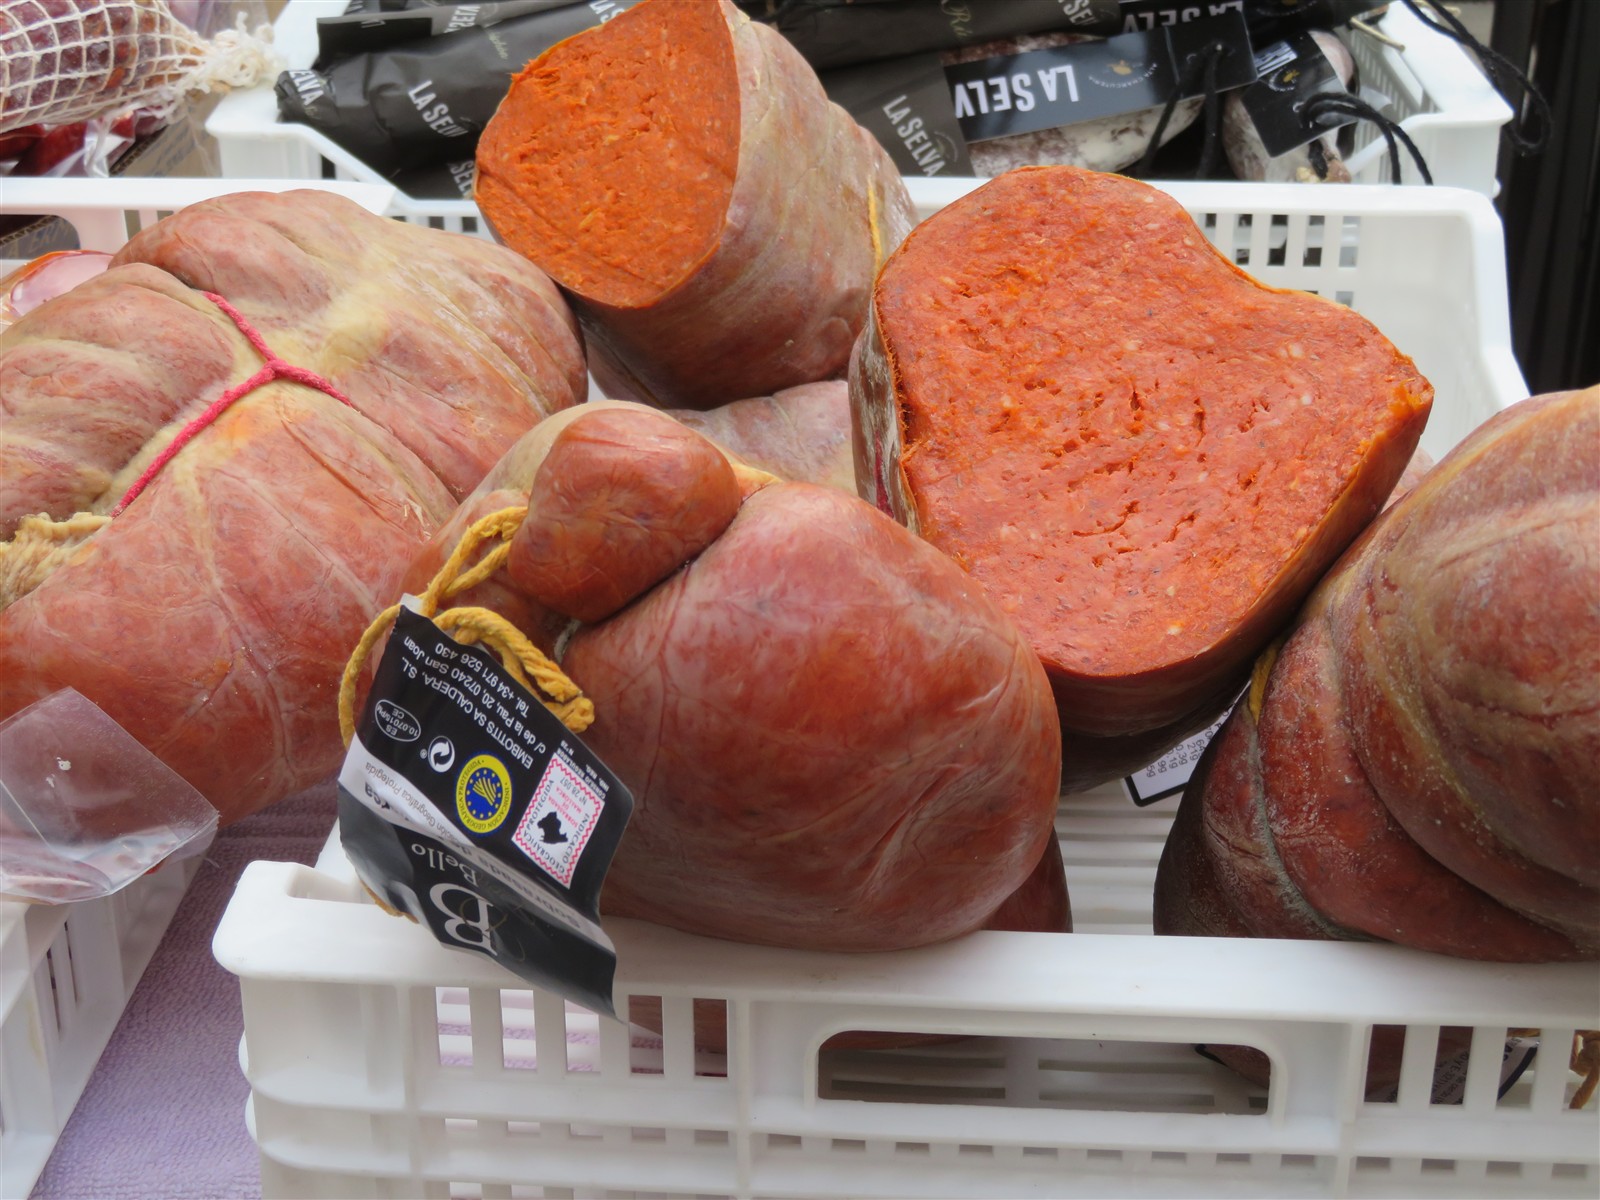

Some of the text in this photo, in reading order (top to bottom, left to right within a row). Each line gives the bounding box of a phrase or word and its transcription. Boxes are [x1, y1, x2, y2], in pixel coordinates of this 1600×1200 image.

[407, 79, 437, 111] LA
[954, 63, 1080, 119] LA SELV
[882, 94, 946, 178] LA SELVA
[403, 636, 547, 754] c/ de la Pau, 20, 07240 San Joan
[434, 642, 530, 718] Tel. +34 971 526 430
[385, 724, 398, 736] ES
[391, 708, 405, 719] CE
[401, 656, 534, 769] EMBOTITS SA CALDERA, S.L.
[365, 761, 401, 796] Protegida
[525, 779, 555, 831] PROTEGIDA
[410, 843, 479, 886] Bello
[429, 882, 498, 957] B
